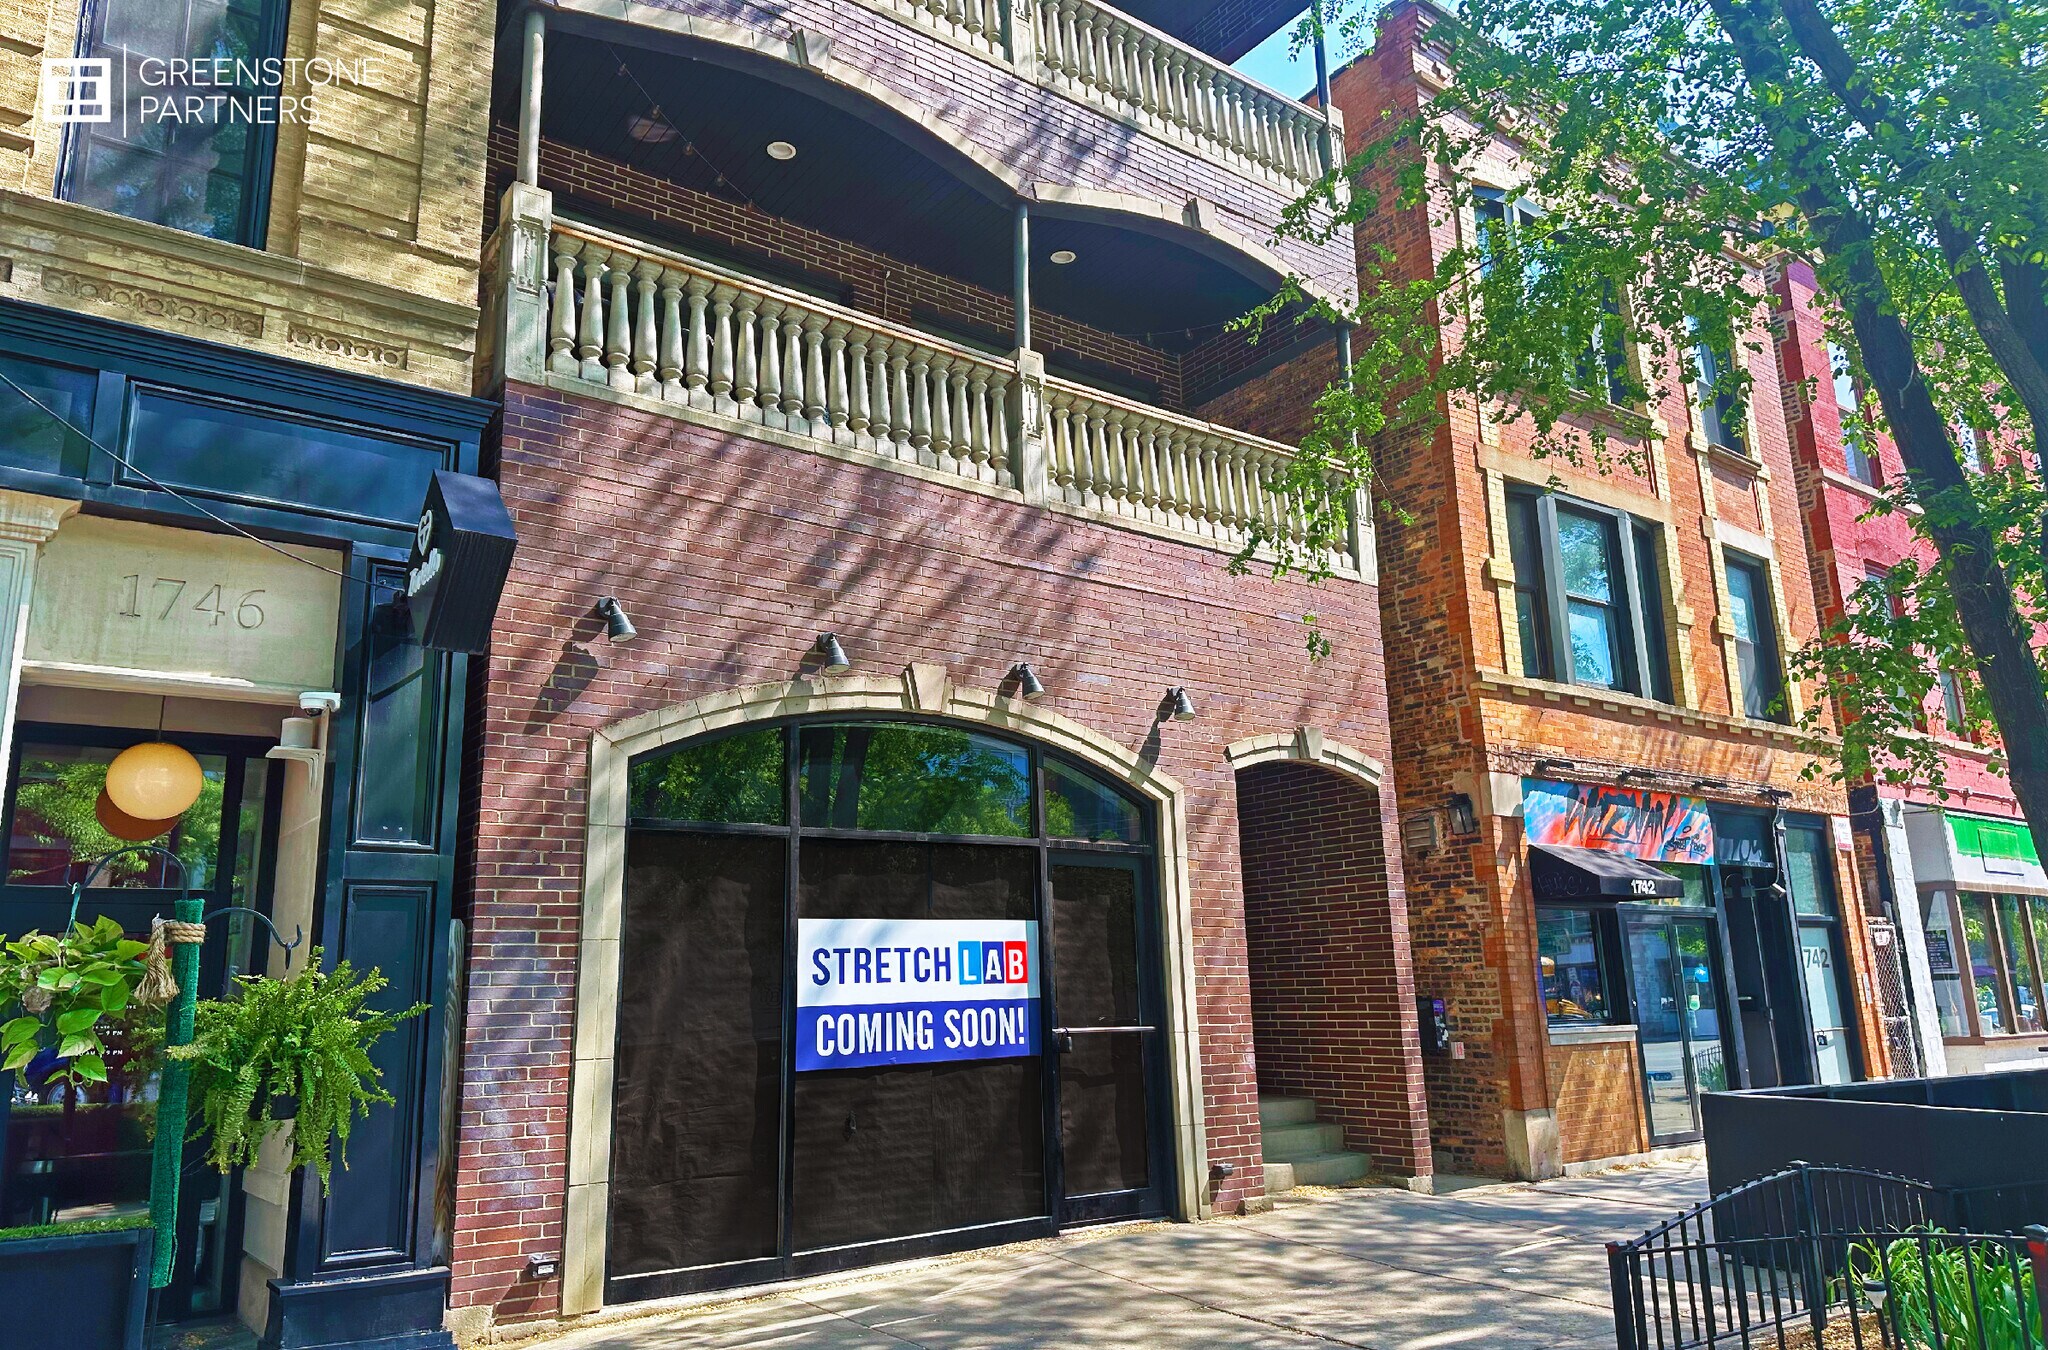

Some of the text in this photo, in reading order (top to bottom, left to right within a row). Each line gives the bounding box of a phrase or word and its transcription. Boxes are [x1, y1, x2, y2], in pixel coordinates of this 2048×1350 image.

[119, 574, 267, 630] 1746
[1630, 879, 1657, 895] 1742
[816, 1006, 1025, 1057] COMING SOON!
